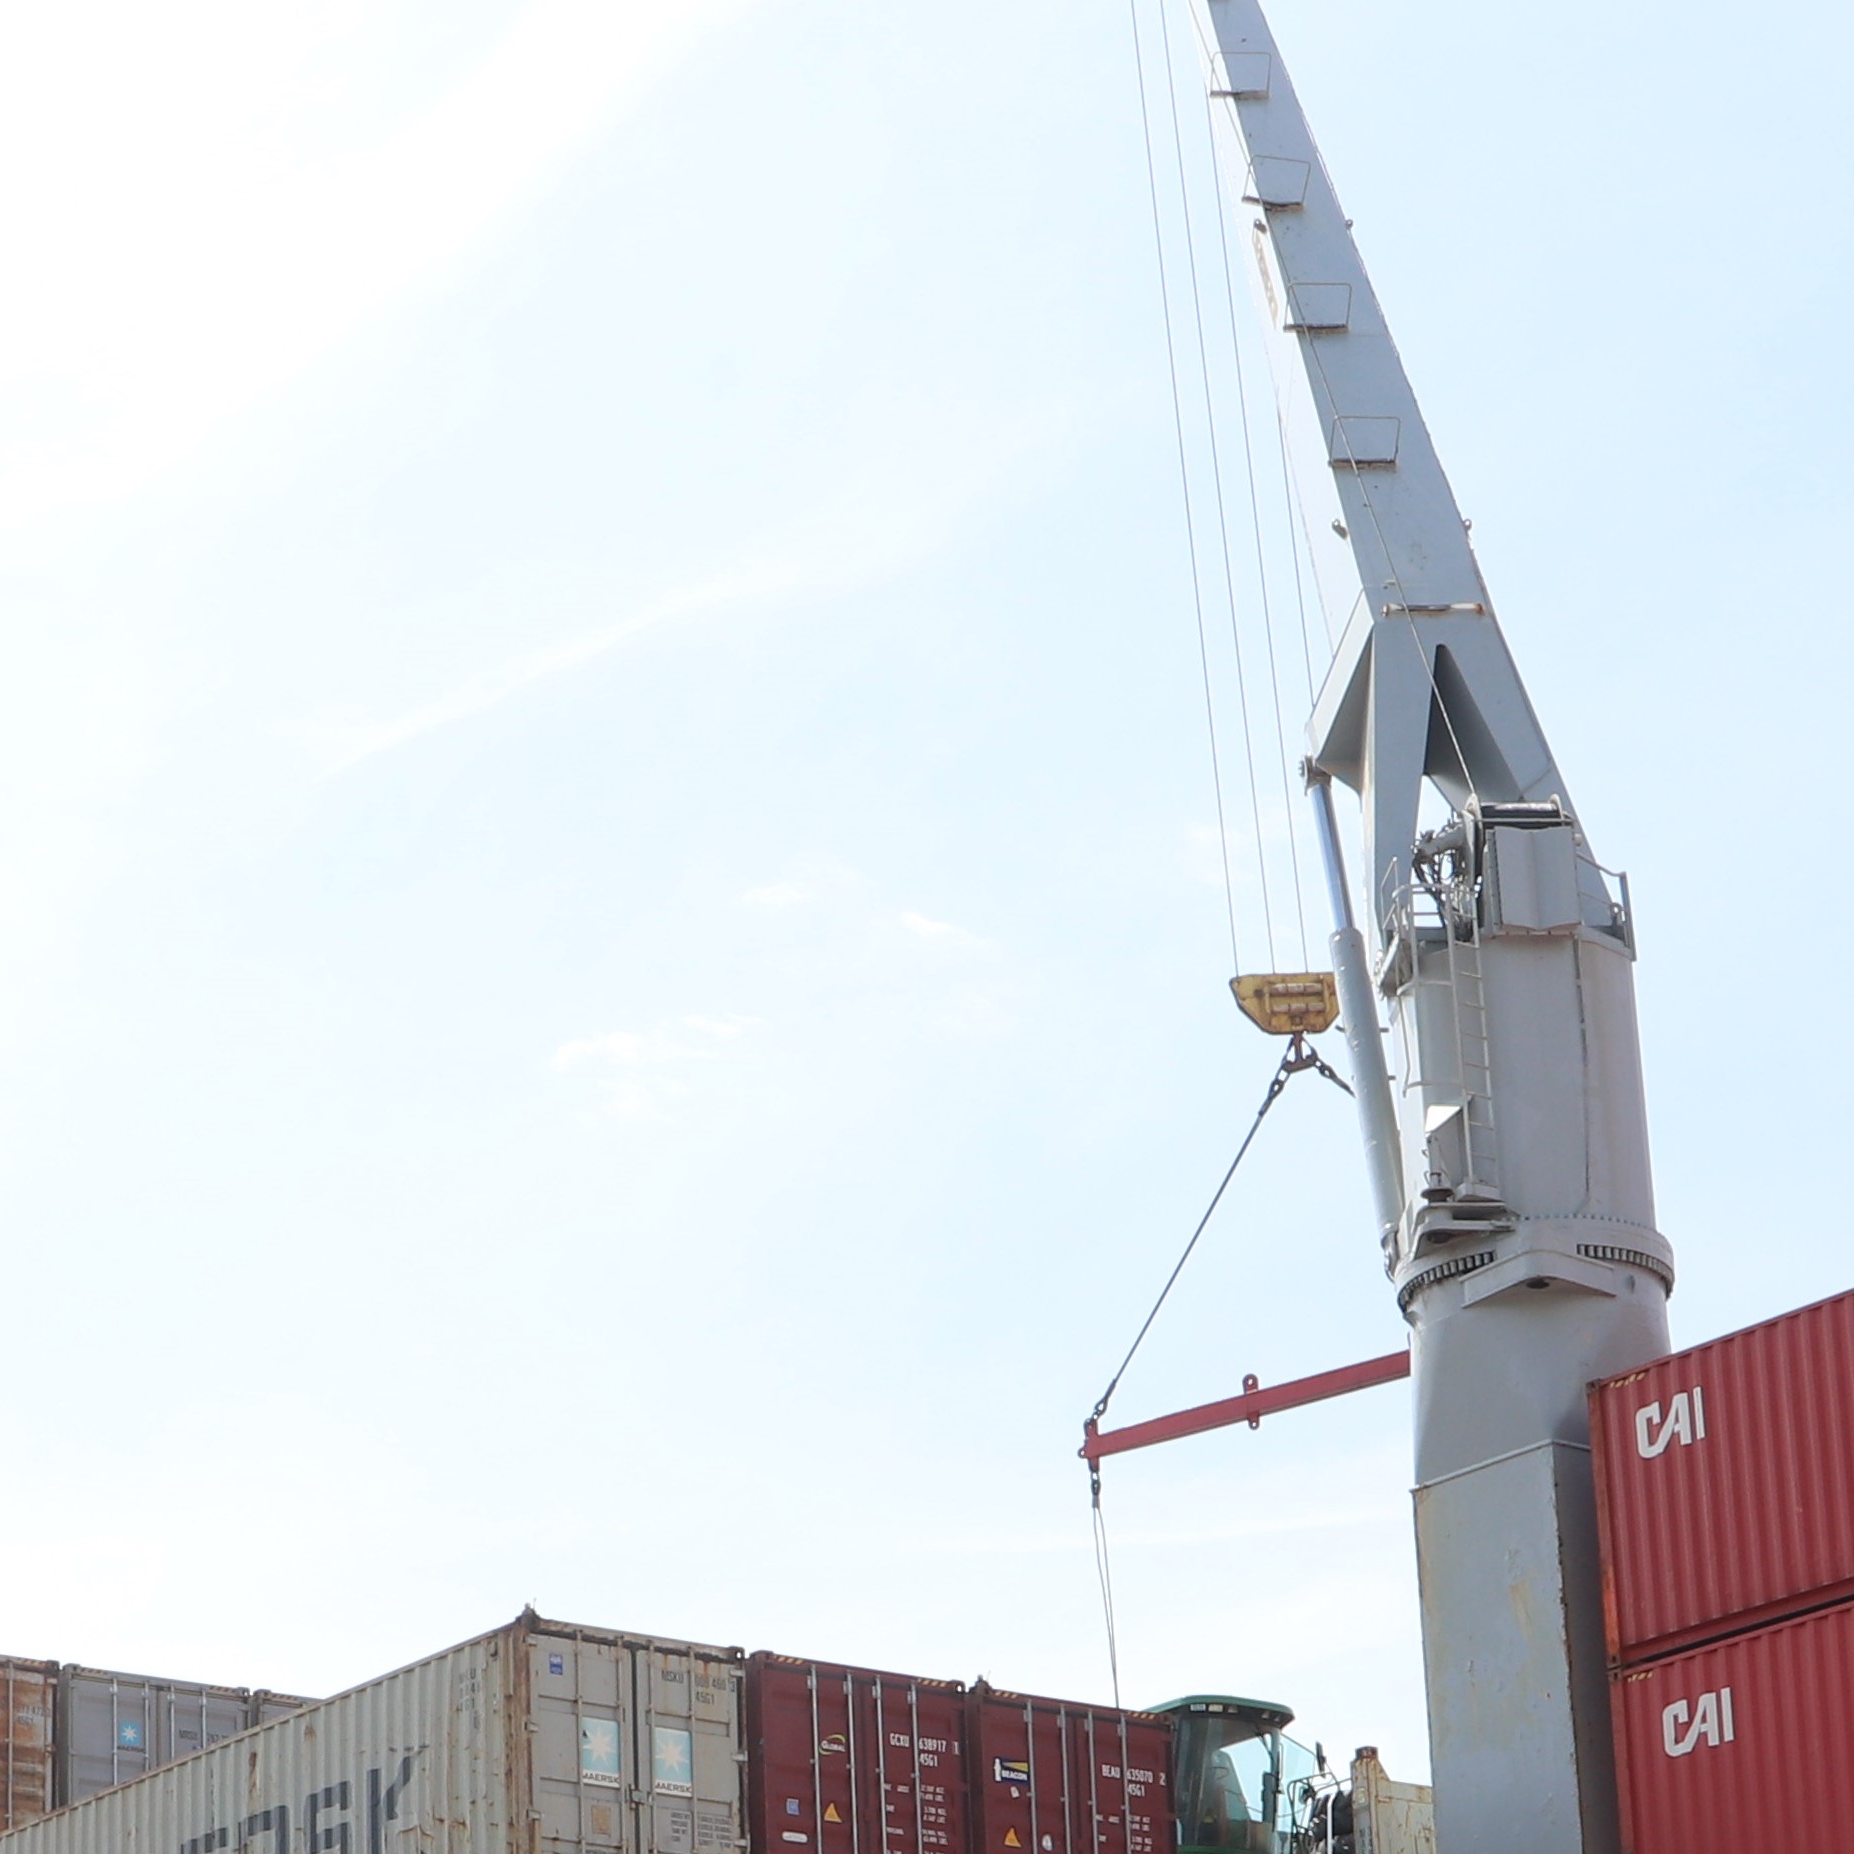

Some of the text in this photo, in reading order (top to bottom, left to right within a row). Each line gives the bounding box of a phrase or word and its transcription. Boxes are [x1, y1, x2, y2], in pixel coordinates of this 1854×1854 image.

[1634, 1385, 1706, 1460] CAI
[1661, 1686, 1737, 1758] CAI
[889, 1732, 911, 1749] GCXU
[918, 1737, 948, 1754] 638917
[919, 1753, 939, 1769] 45G1
[1001, 1769, 1029, 1782] BEACON
[1101, 1763, 1122, 1780] BEAU
[1126, 1768, 1155, 1785] 635070
[1126, 1782, 1146, 1798] 45G1
